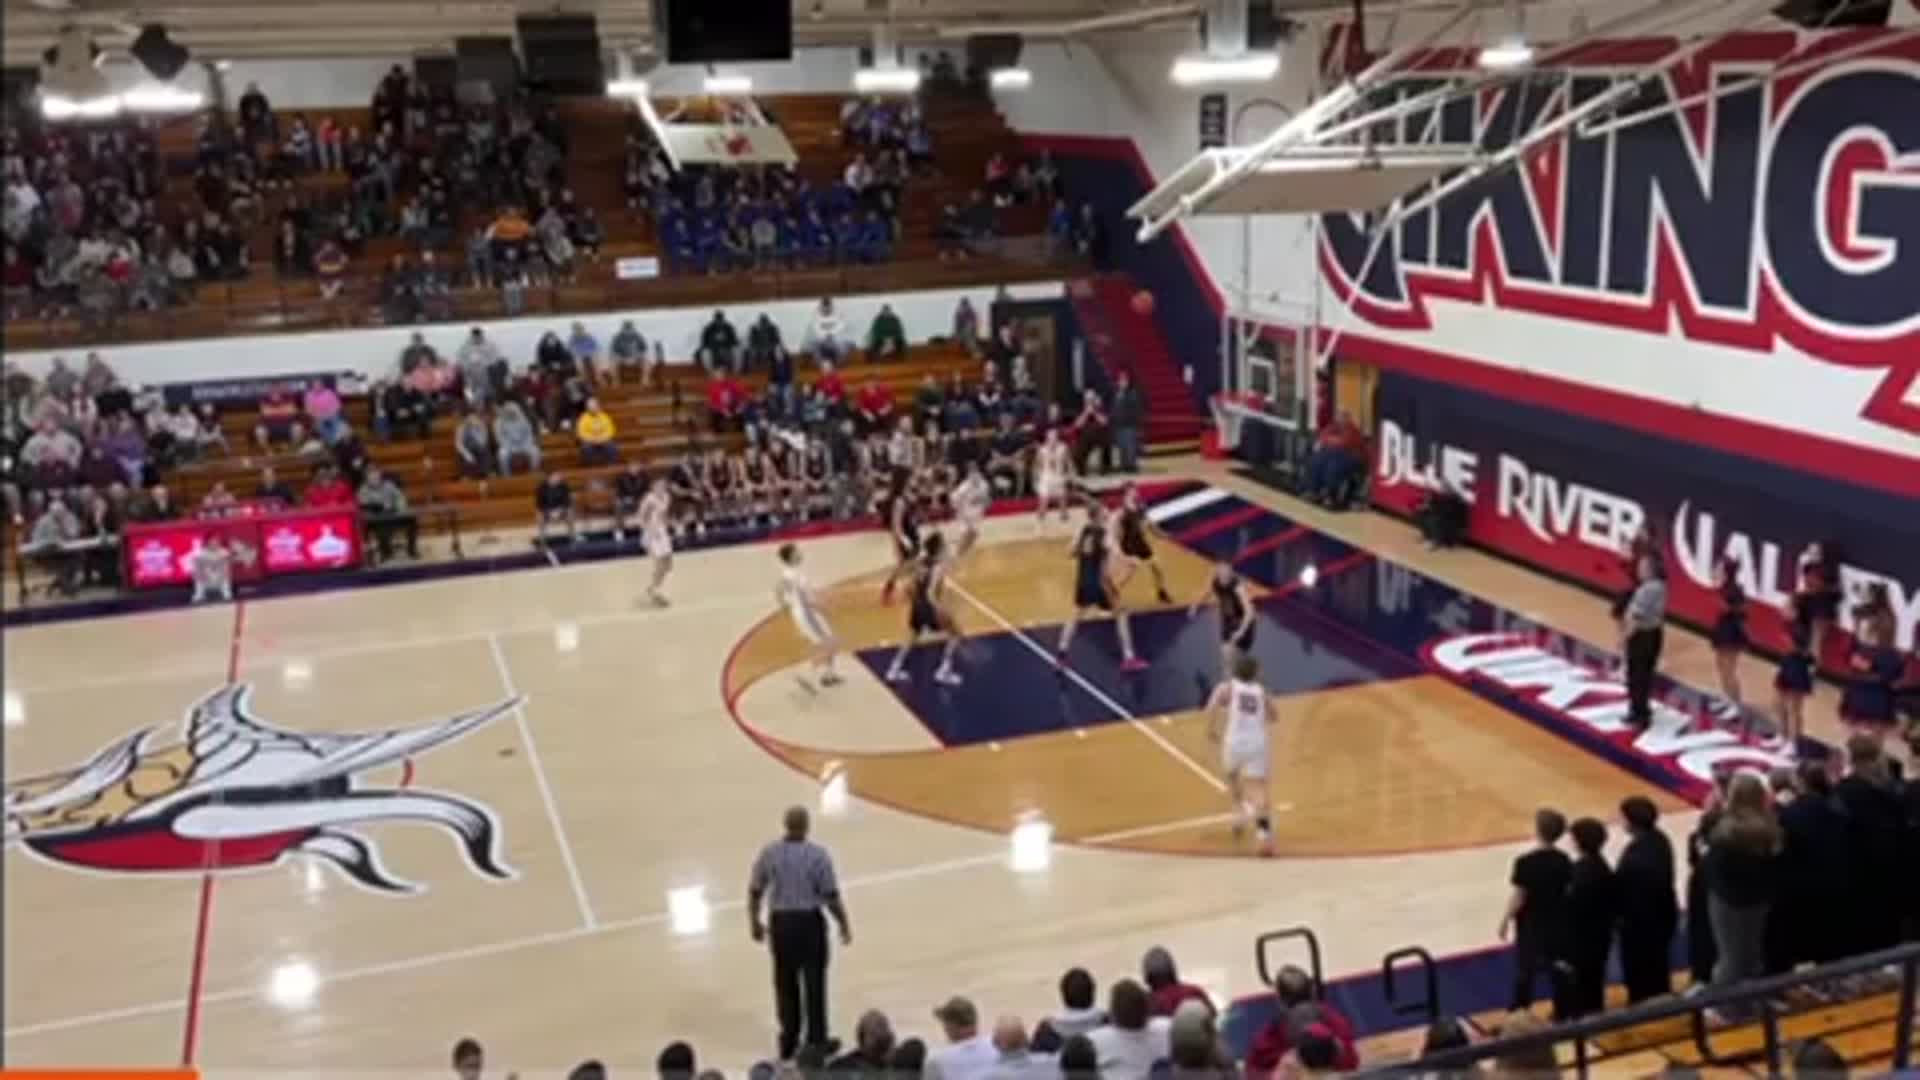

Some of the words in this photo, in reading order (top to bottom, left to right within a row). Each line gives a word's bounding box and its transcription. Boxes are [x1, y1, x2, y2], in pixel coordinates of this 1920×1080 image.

[1316, 36, 1920, 352] VIKING
[1377, 418, 1478, 504] BLUE
[1496, 452, 1645, 559] RIVER
